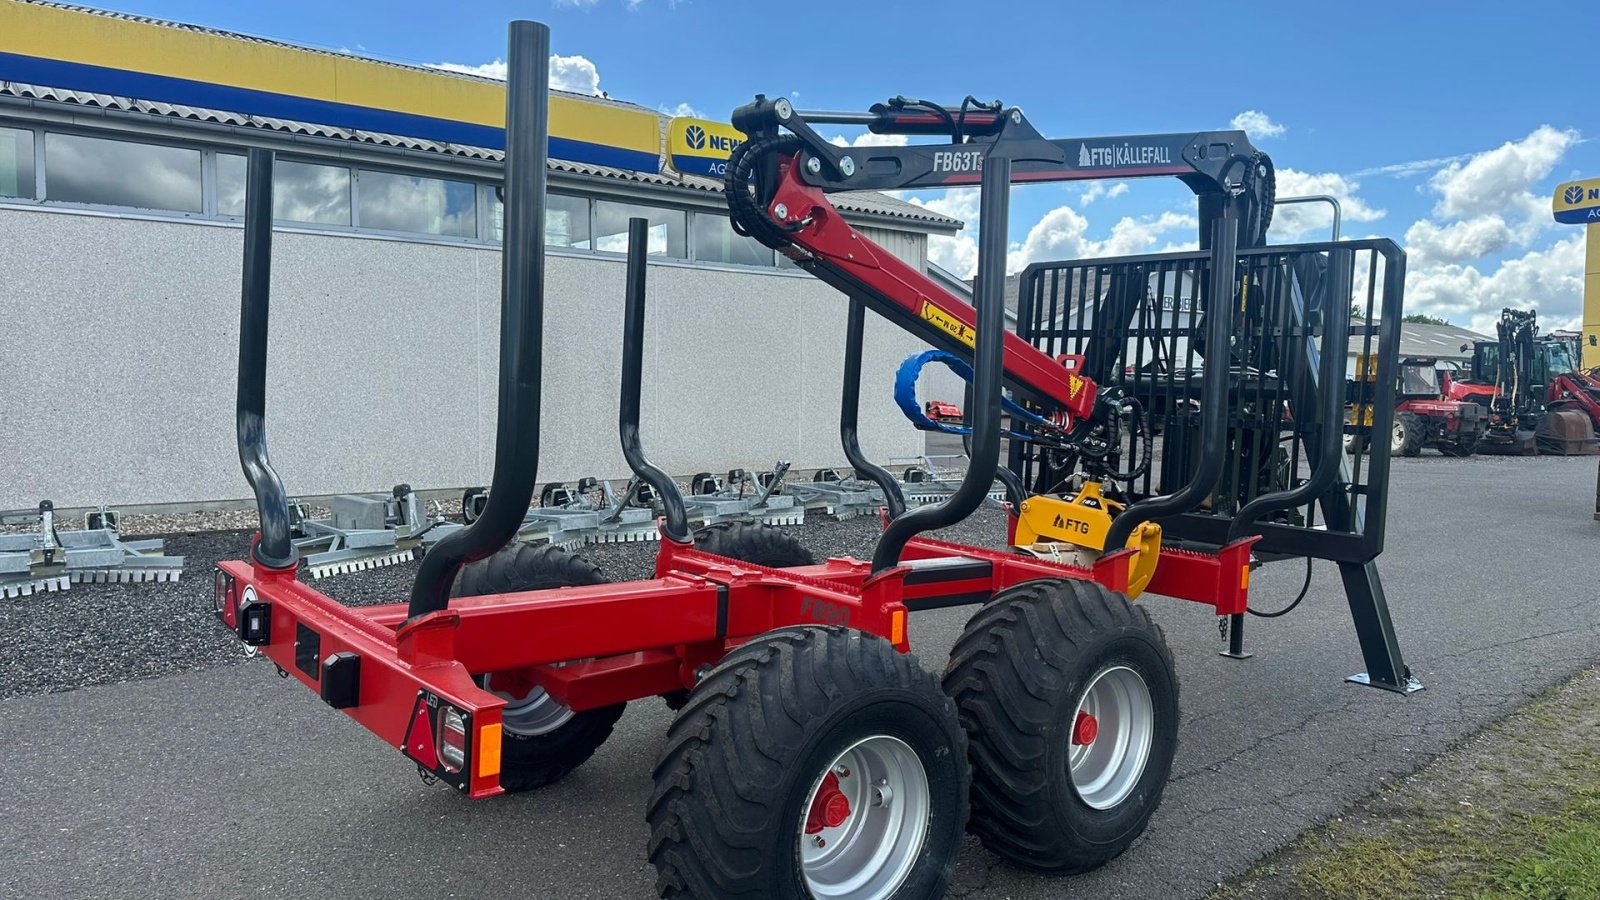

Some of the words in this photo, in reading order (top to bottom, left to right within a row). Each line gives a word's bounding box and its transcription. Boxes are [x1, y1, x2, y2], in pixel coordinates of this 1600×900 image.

[933, 151, 981, 172] FB63T
[1091, 147, 1112, 166] FTG
[1065, 518, 1089, 534] FTG
[801, 595, 851, 627] FB90
[426, 691, 438, 709] LED
